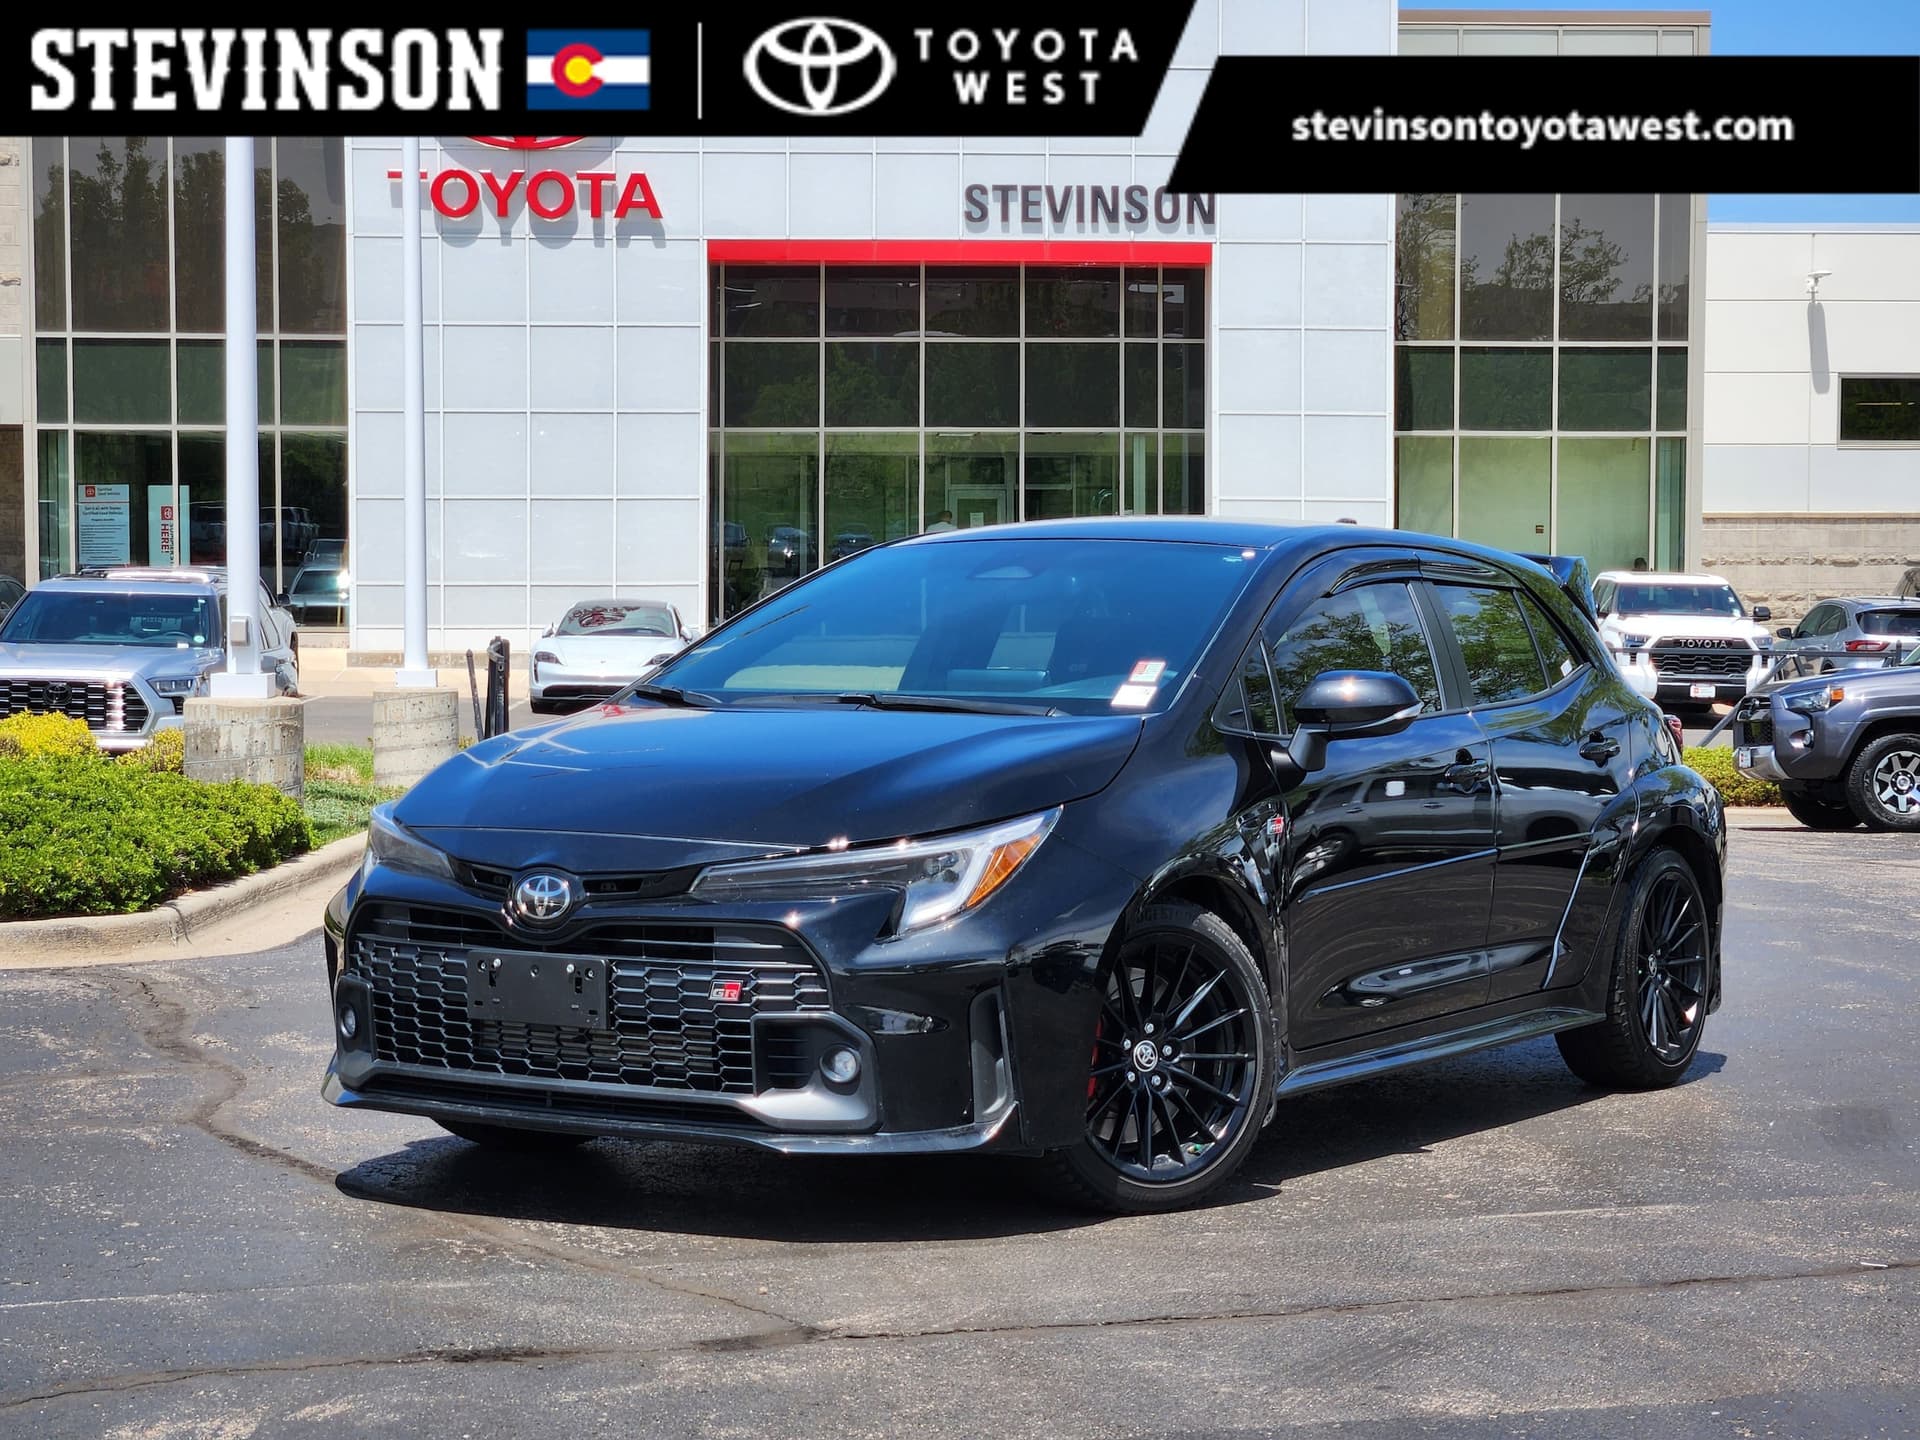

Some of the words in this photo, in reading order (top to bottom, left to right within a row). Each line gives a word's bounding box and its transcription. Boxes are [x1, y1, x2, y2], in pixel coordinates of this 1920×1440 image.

[963, 183, 1216, 225] STEVINSON
[161, 523, 170, 553] HERE!
[1679, 639, 1728, 649] TOYOTA
